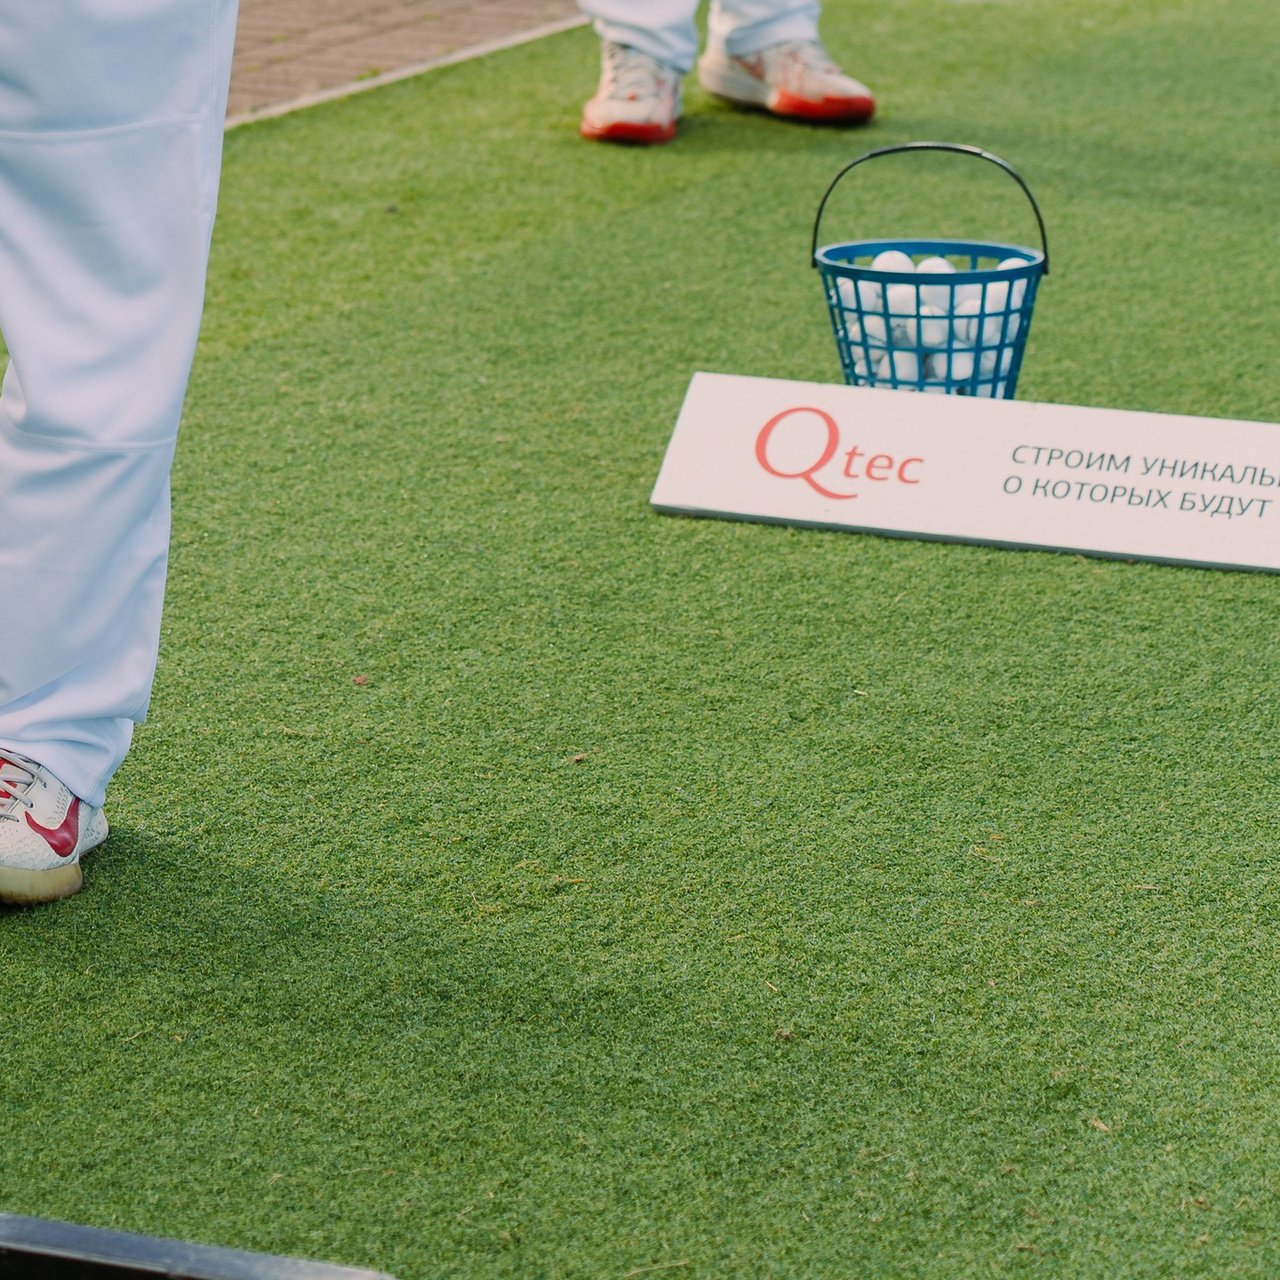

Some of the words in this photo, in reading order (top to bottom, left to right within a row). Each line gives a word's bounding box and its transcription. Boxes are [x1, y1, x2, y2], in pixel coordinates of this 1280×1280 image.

[754, 406, 925, 500] Qtec
[1011, 444, 1132, 474] СТРОИМ
[1140, 456, 1280, 488] УНИКАЛЬ
[1003, 475, 1022, 495] О
[1031, 477, 1172, 510] КОТОРЫХ
[1179, 491, 1273, 520] БУДУТ
